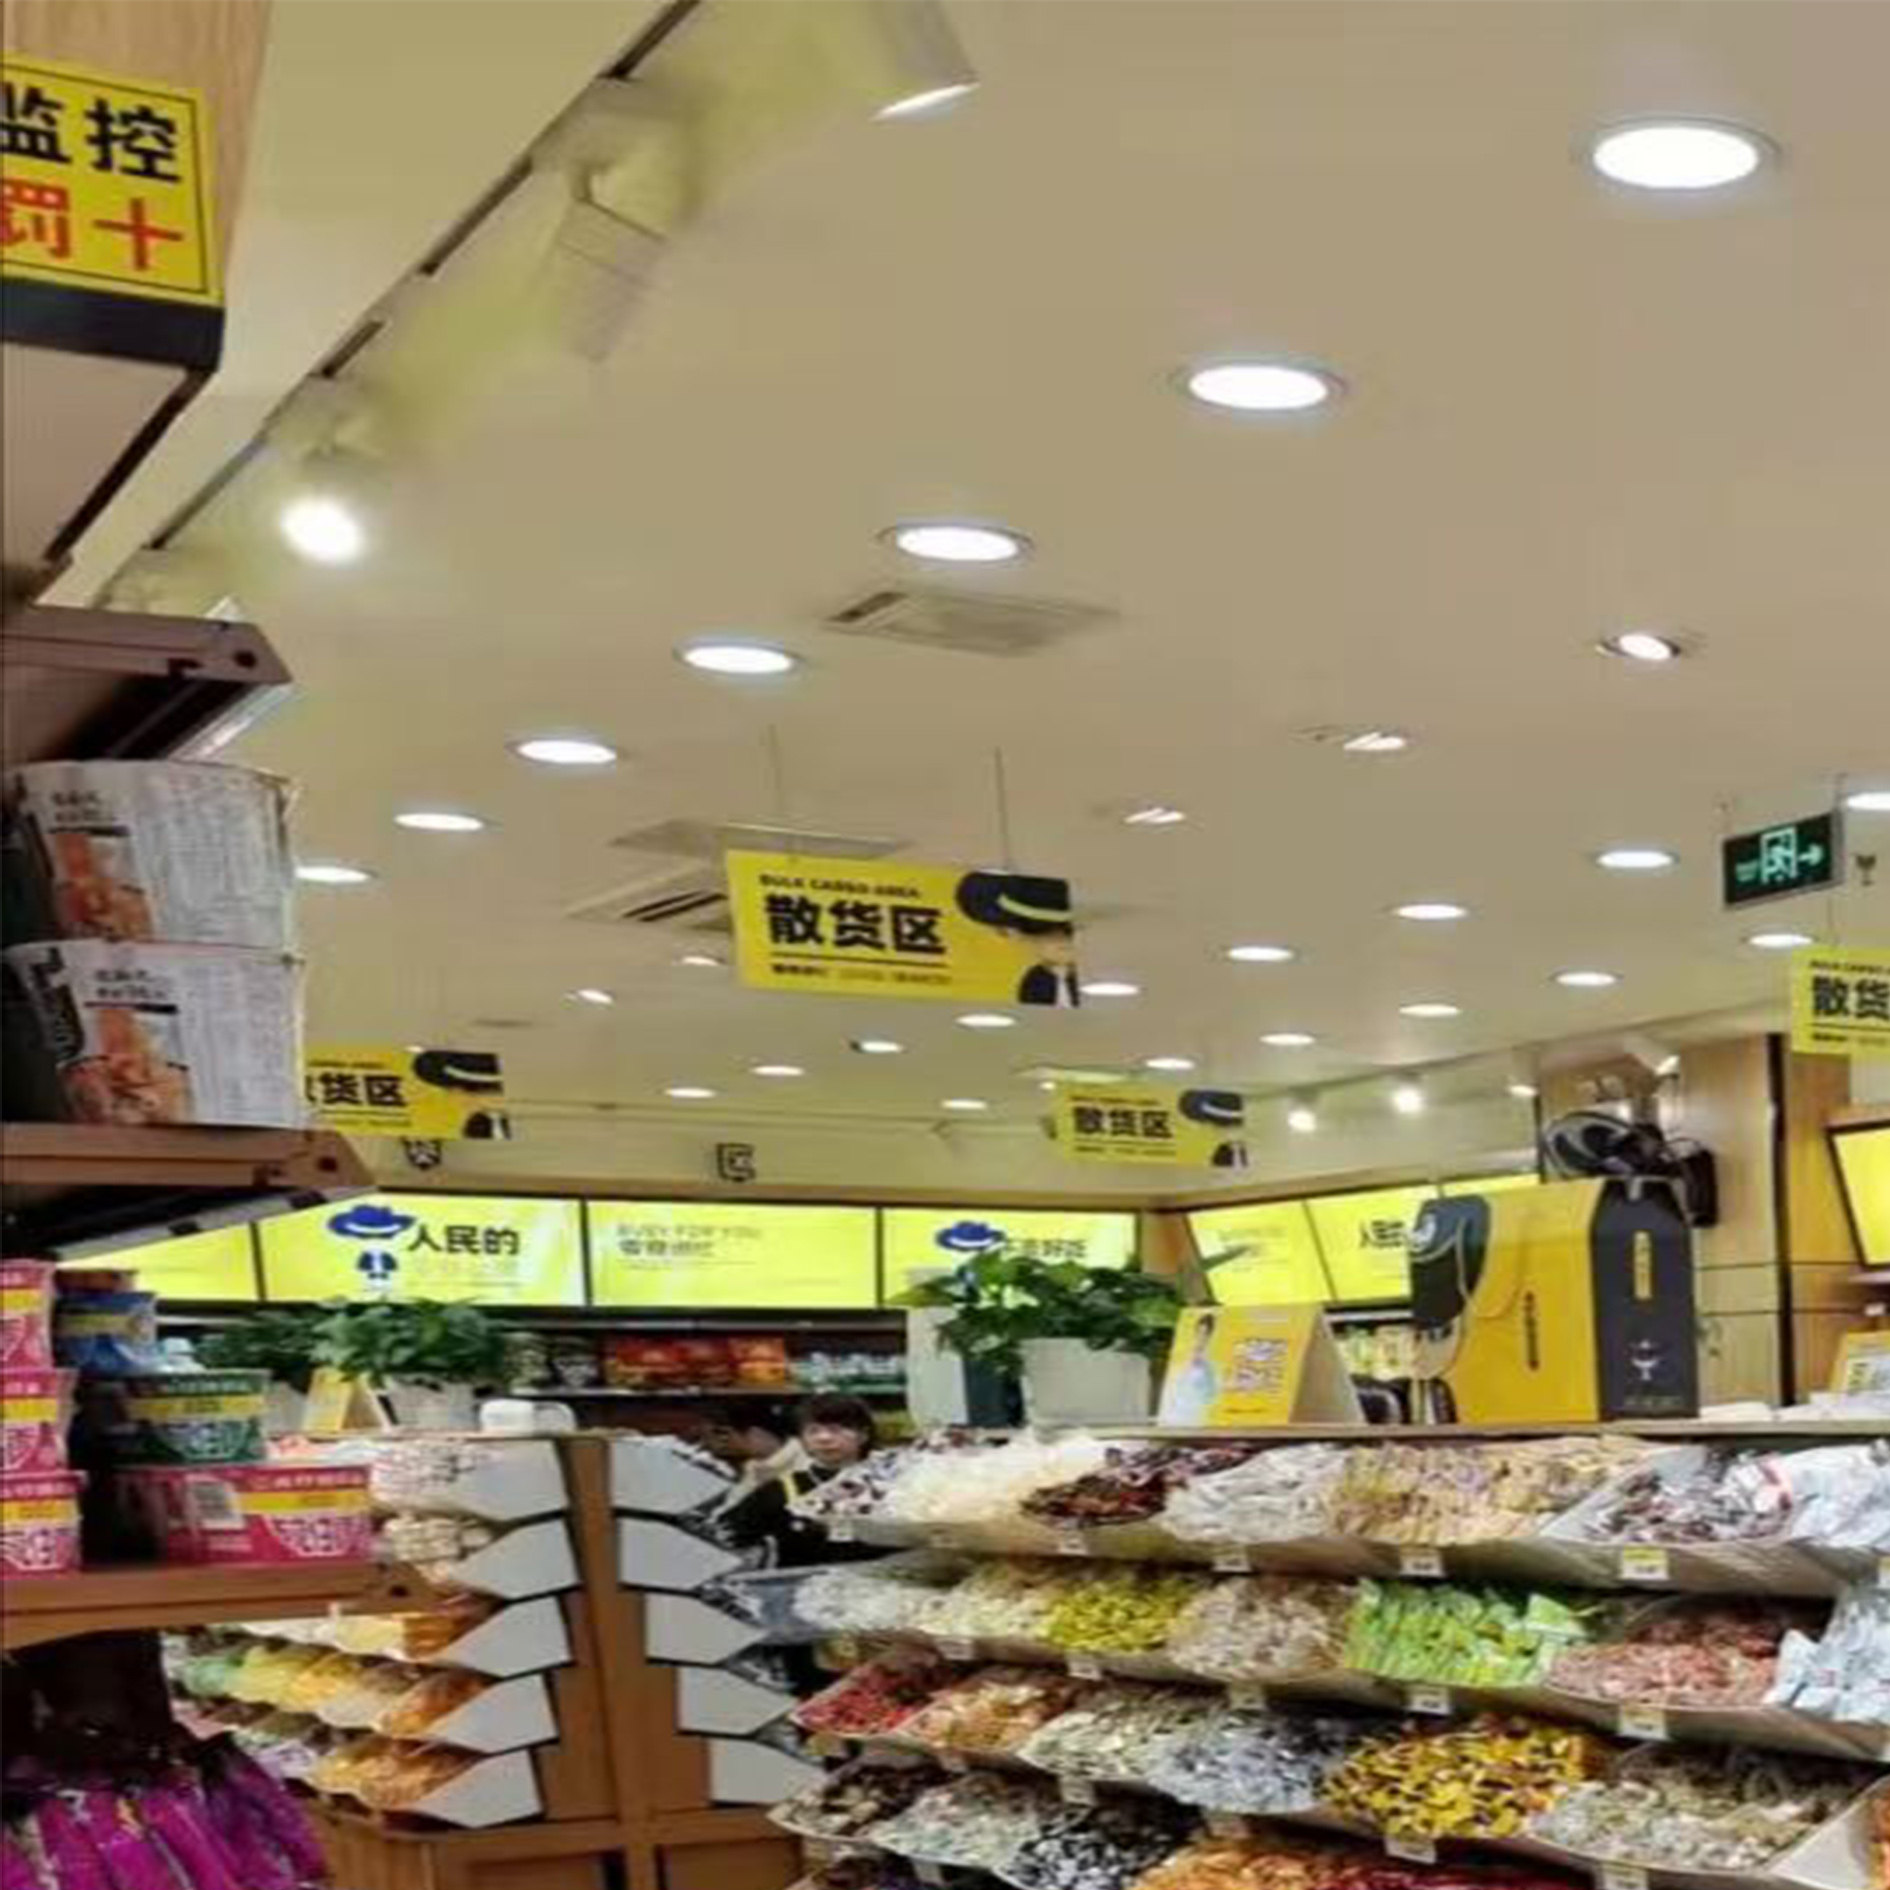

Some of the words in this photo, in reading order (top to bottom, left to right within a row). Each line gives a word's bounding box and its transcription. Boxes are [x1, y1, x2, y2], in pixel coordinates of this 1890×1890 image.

[0, 82, 183, 183] 监控
[765, 894, 948, 955] 散货区
[305, 1072, 408, 1108] 货区
[1073, 1106, 1174, 1139] 散货区
[408, 1225, 519, 1256] 人民的
